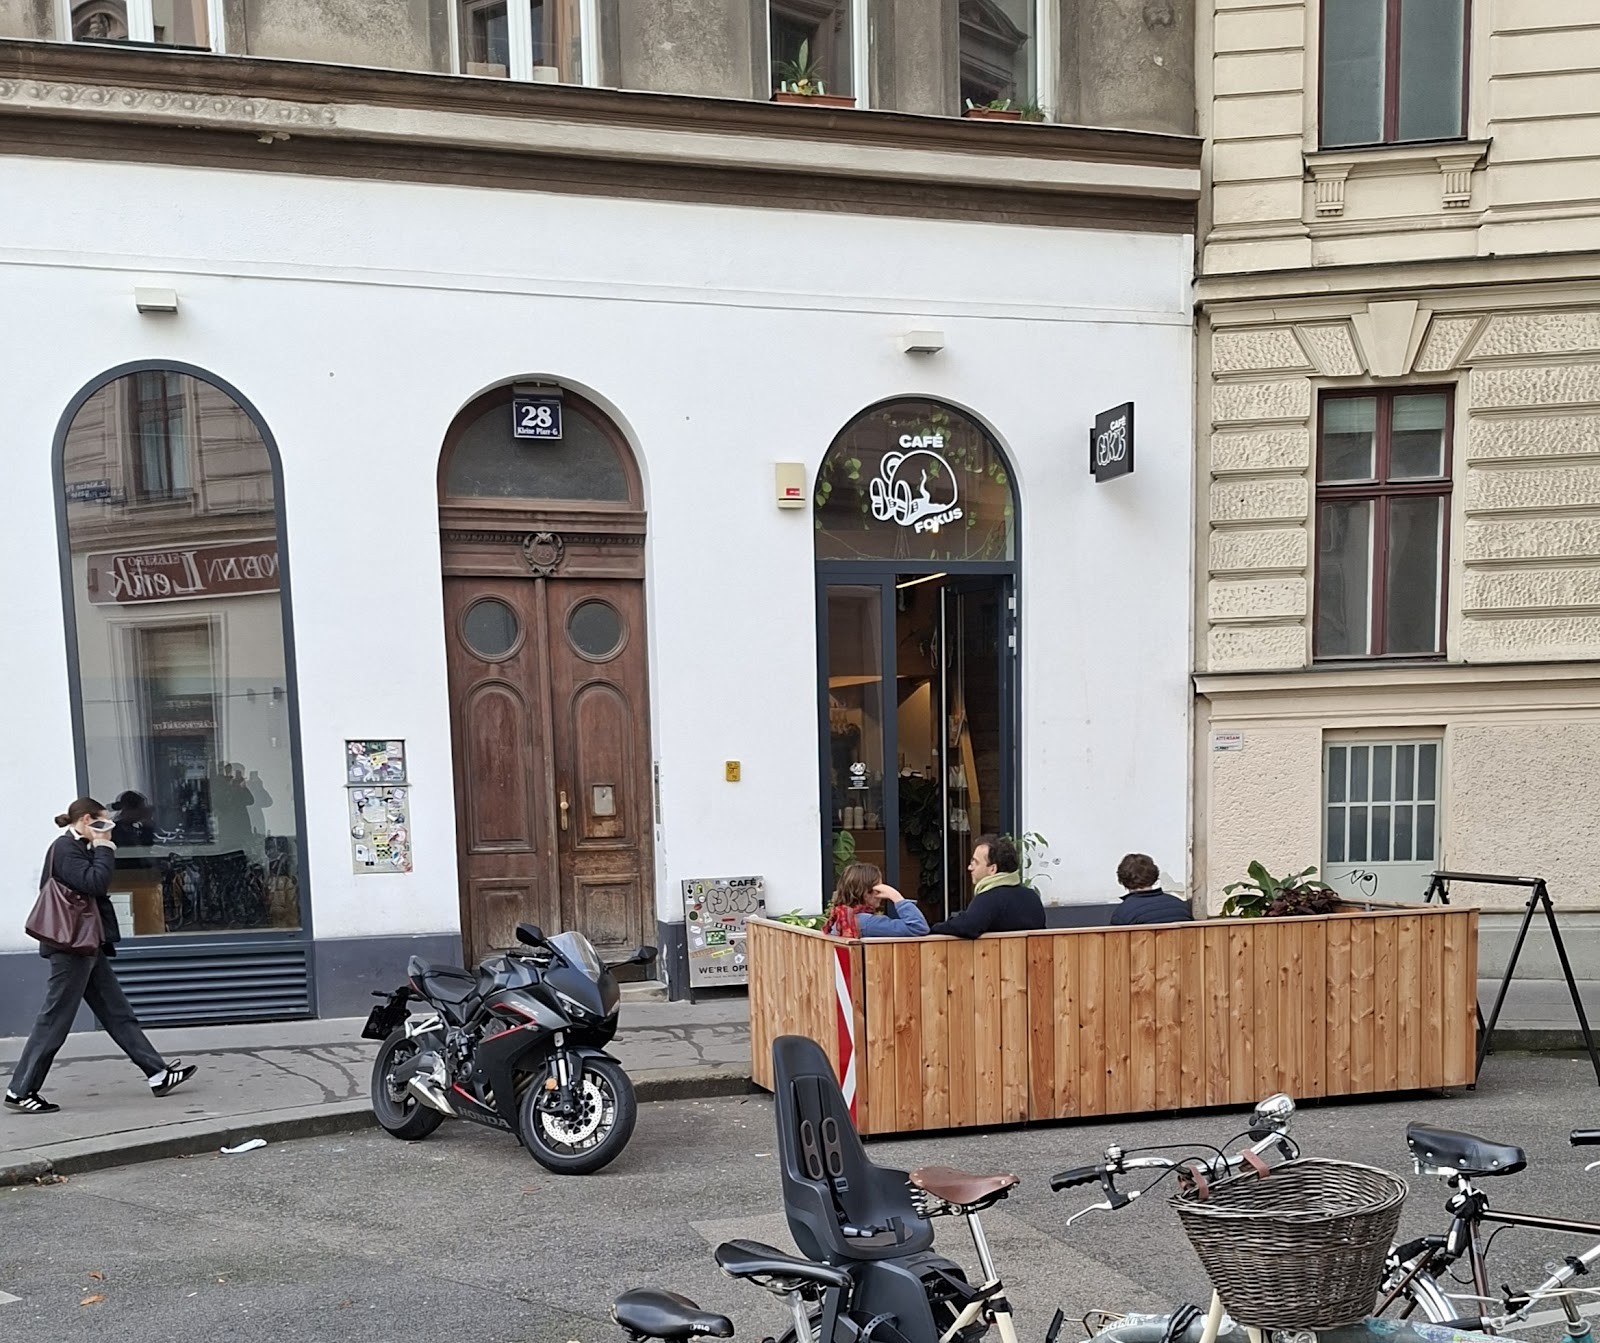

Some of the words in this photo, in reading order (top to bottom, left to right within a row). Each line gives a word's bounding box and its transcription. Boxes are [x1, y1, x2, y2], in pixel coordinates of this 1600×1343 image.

[521, 405, 553, 428] 28
[1110, 415, 1126, 431] CAFÉ
[899, 433, 944, 449] CAFÉ
[914, 507, 963, 534] FOKUS
[729, 877, 758, 888] CAFÉ
[706, 887, 760, 915] FOKUS
[699, 965, 729, 974] WE'RE
[457, 1106, 512, 1130] HONDA
